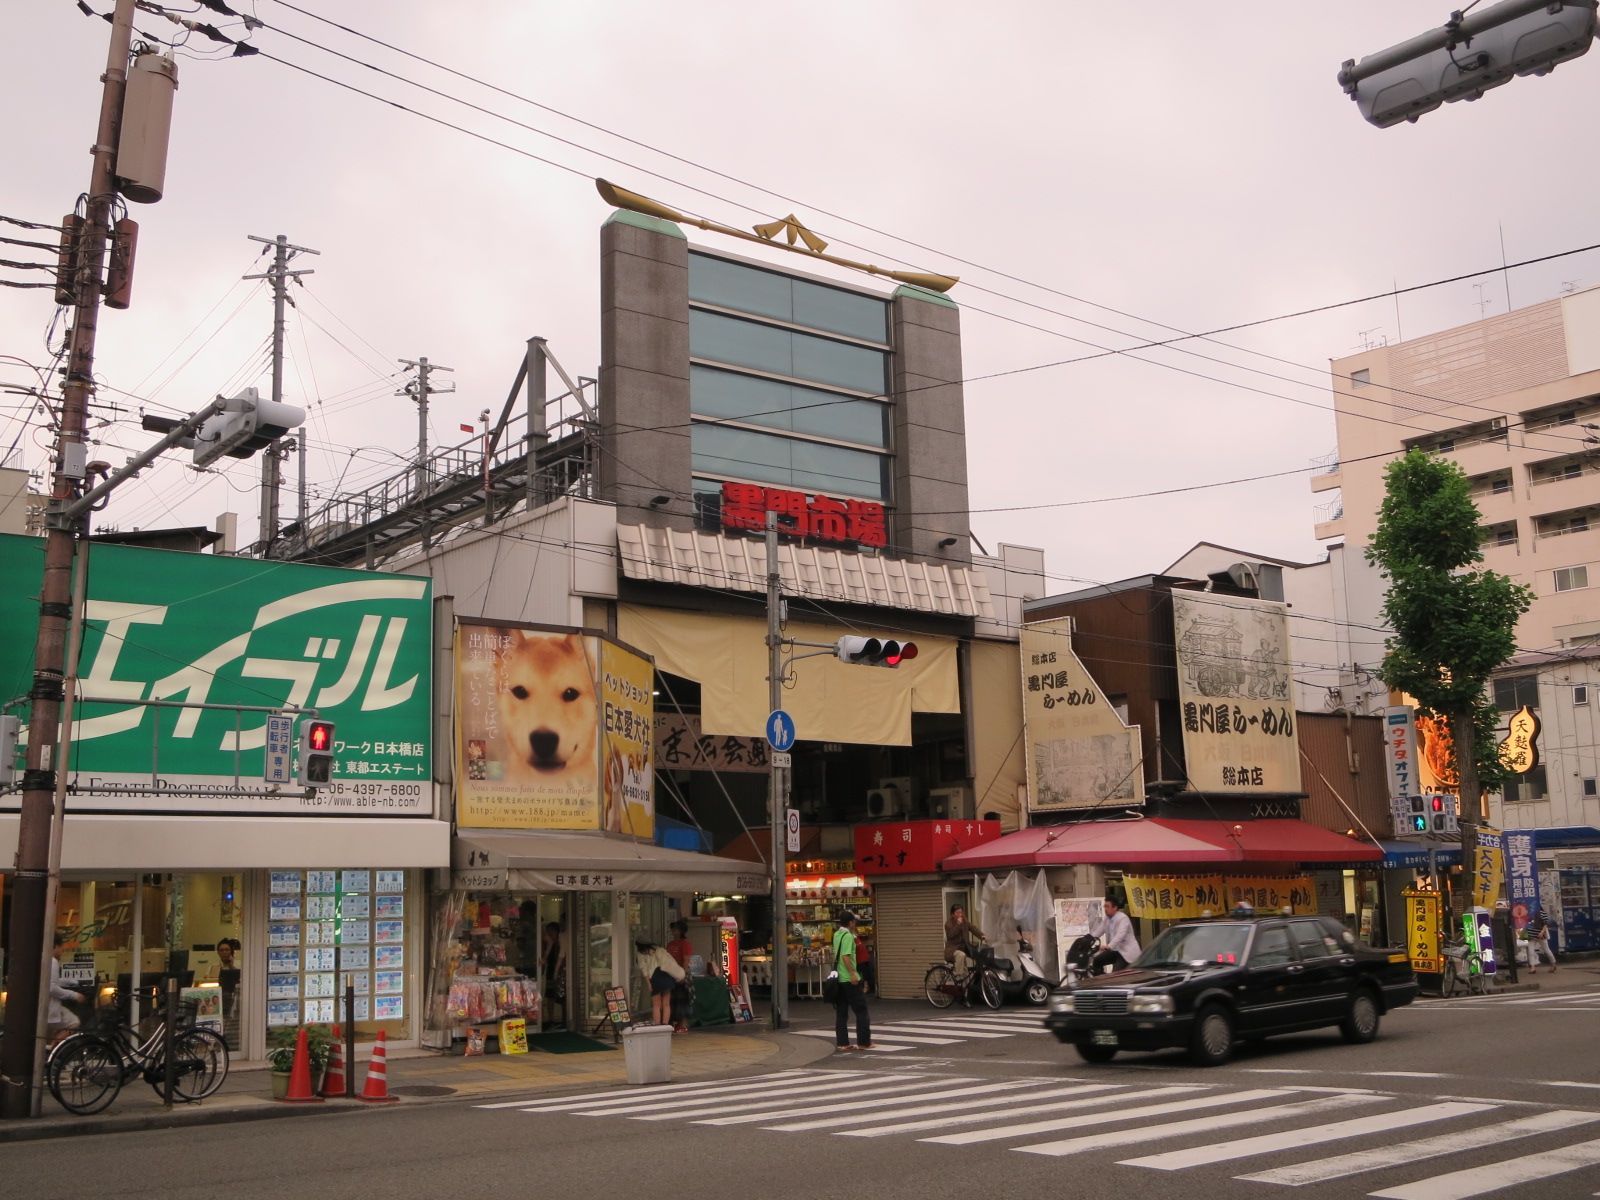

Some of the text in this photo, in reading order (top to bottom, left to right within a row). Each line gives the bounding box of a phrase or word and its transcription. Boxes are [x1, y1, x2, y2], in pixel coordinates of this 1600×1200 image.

[78, 580, 428, 751] エイブル
[1028, 671, 1068, 692] 黒門屋
[605, 701, 650, 746] 日本愛犬社
[270, 720, 279, 753] 自転車
[280, 720, 290, 754] 歩行者
[293, 738, 425, 757] ネワーク日本橋店
[273, 756, 283, 779] 専用
[346, 762, 425, 776] 東都エステート
[1222, 765, 1264, 786] 総本店
[329, 783, 421, 796] 06-4397-6800
[873, 828, 912, 847] 寿司
[966, 823, 984, 836] すし
[1508, 834, 1532, 877] 護身
[64, 970, 93, 979] OPEN
